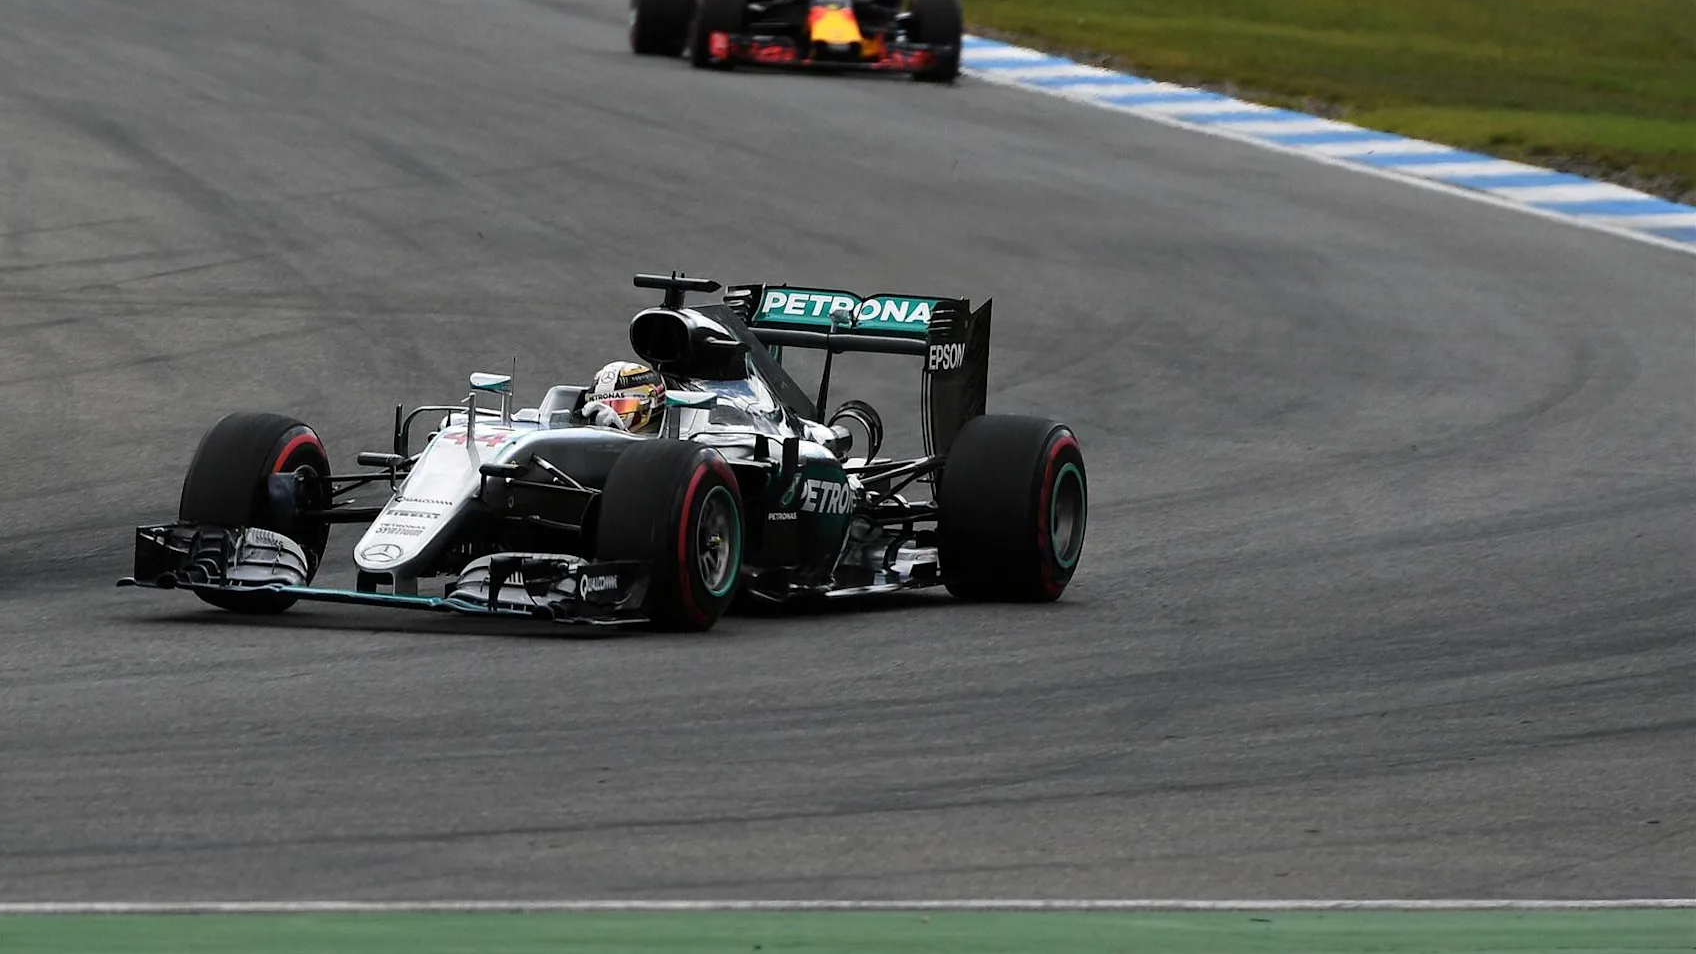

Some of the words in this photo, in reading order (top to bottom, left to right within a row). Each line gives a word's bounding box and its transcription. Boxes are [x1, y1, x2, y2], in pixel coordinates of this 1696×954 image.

[762, 292, 932, 324] PETRONA
[928, 343, 965, 370] EPSON
[768, 512, 798, 520] PETRONAS
